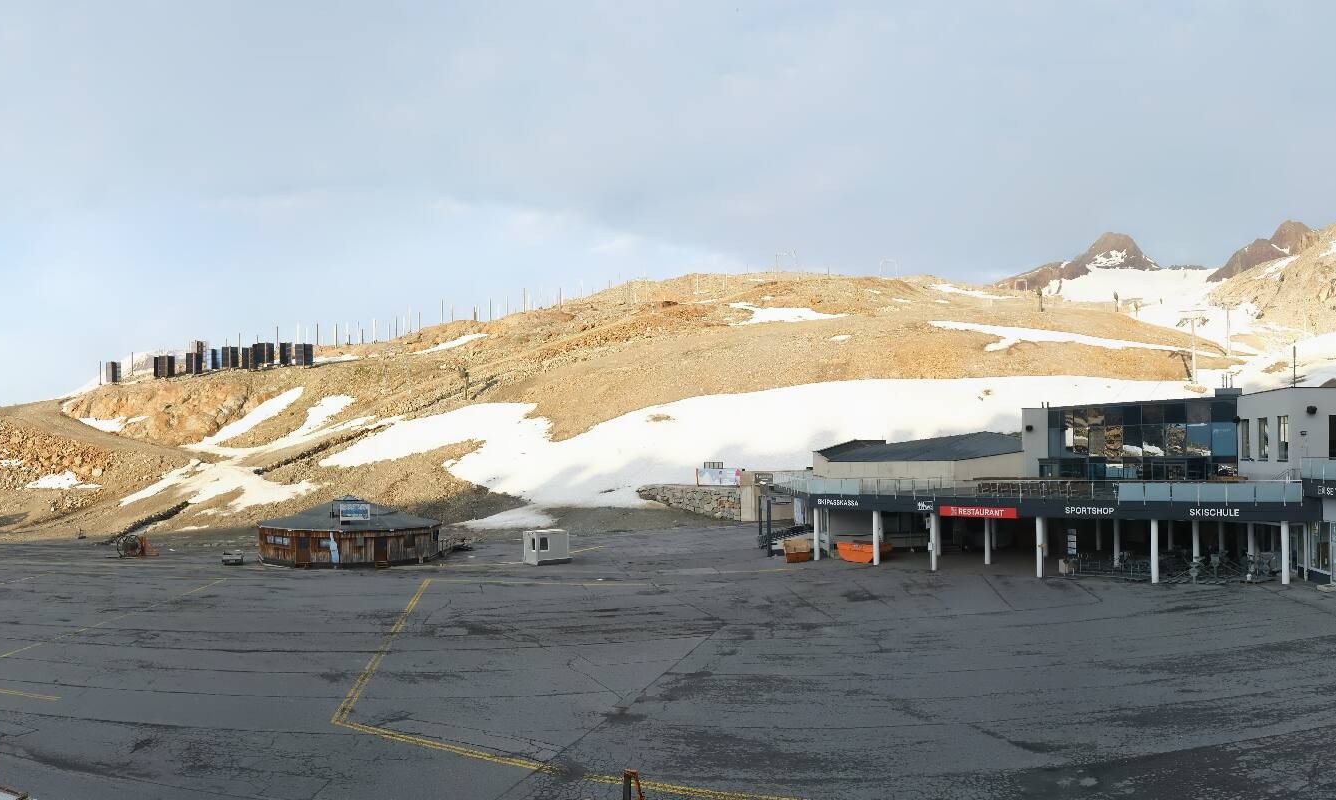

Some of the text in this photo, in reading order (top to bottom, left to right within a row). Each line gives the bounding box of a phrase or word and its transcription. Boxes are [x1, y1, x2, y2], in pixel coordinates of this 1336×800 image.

[958, 507, 1005, 517] RESTAURANT
[1064, 506, 1115, 515] SPORTSHOP
[1189, 508, 1240, 517] SKISCHULE
